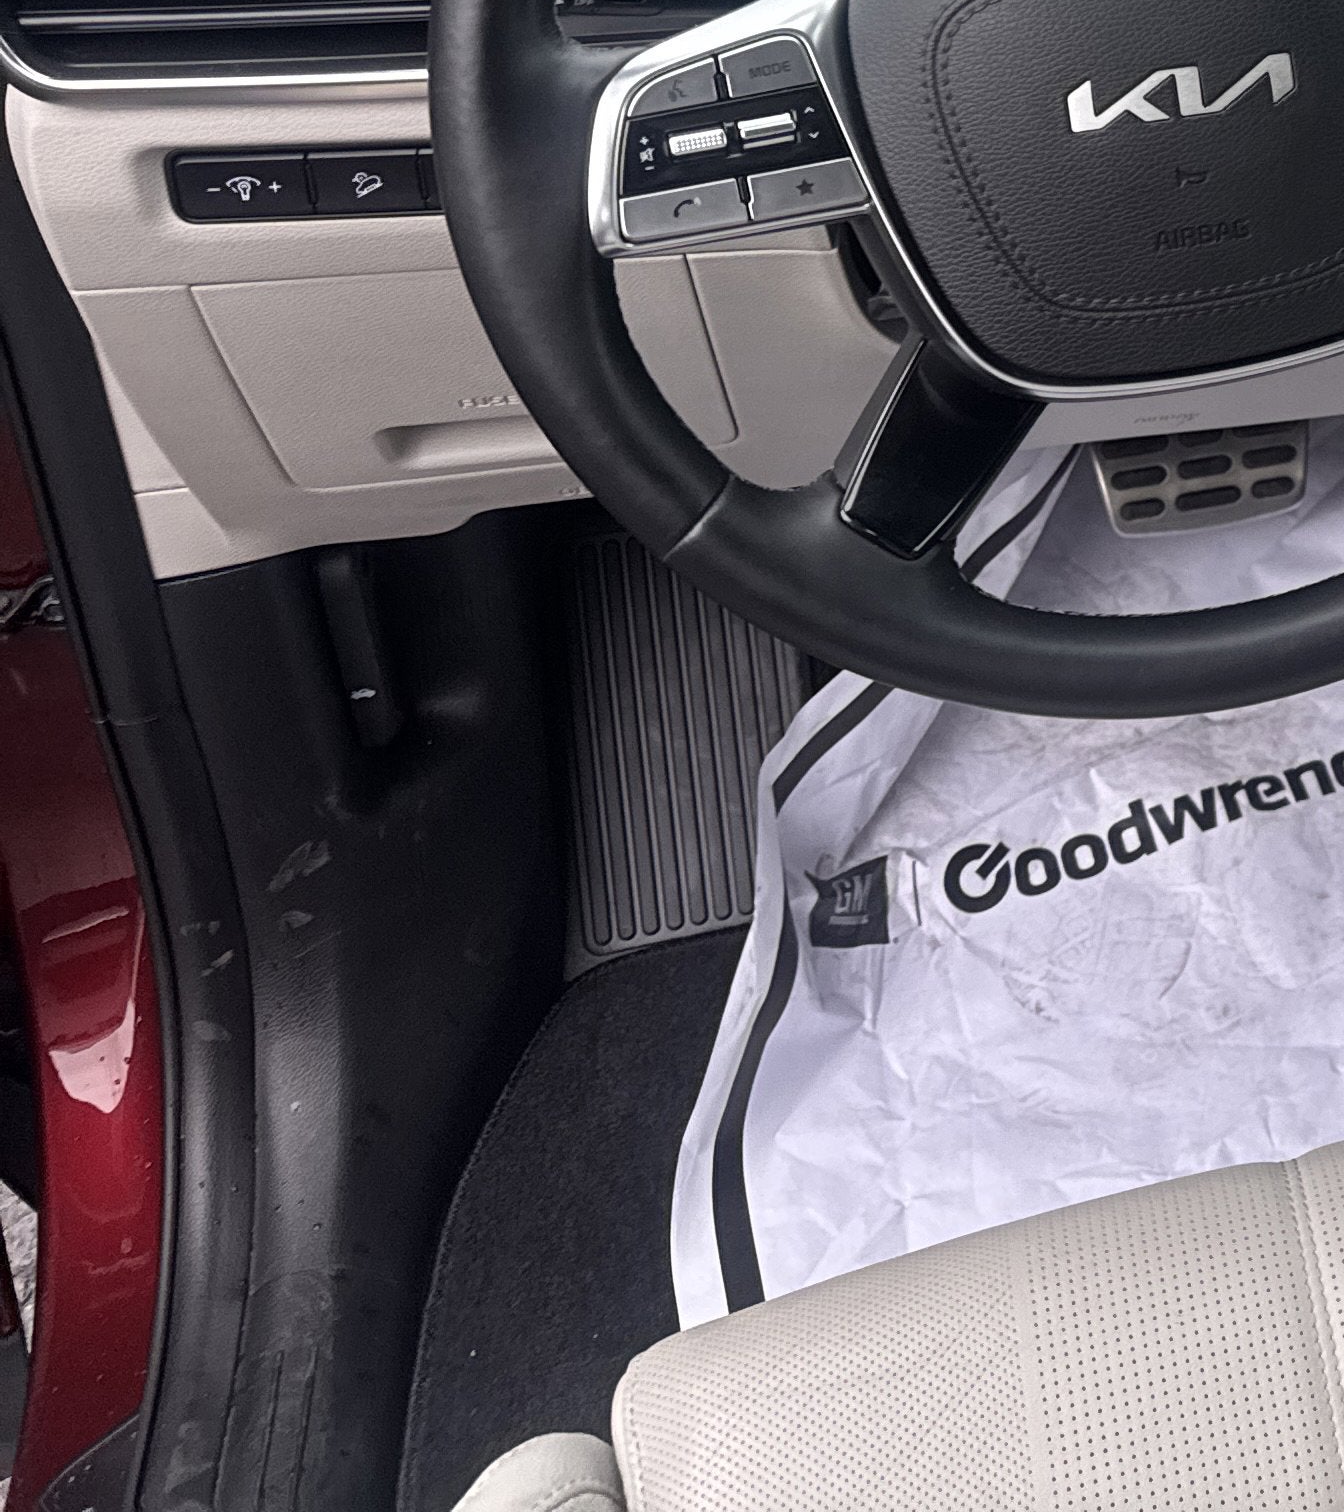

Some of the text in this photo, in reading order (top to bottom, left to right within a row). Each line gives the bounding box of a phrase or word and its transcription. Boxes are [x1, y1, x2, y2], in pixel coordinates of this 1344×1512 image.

[749, 60, 792, 80] MODE
[1154, 219, 1253, 252] AIRBAG
[458, 394, 520, 409] FUSE
[832, 873, 874, 914] GM
